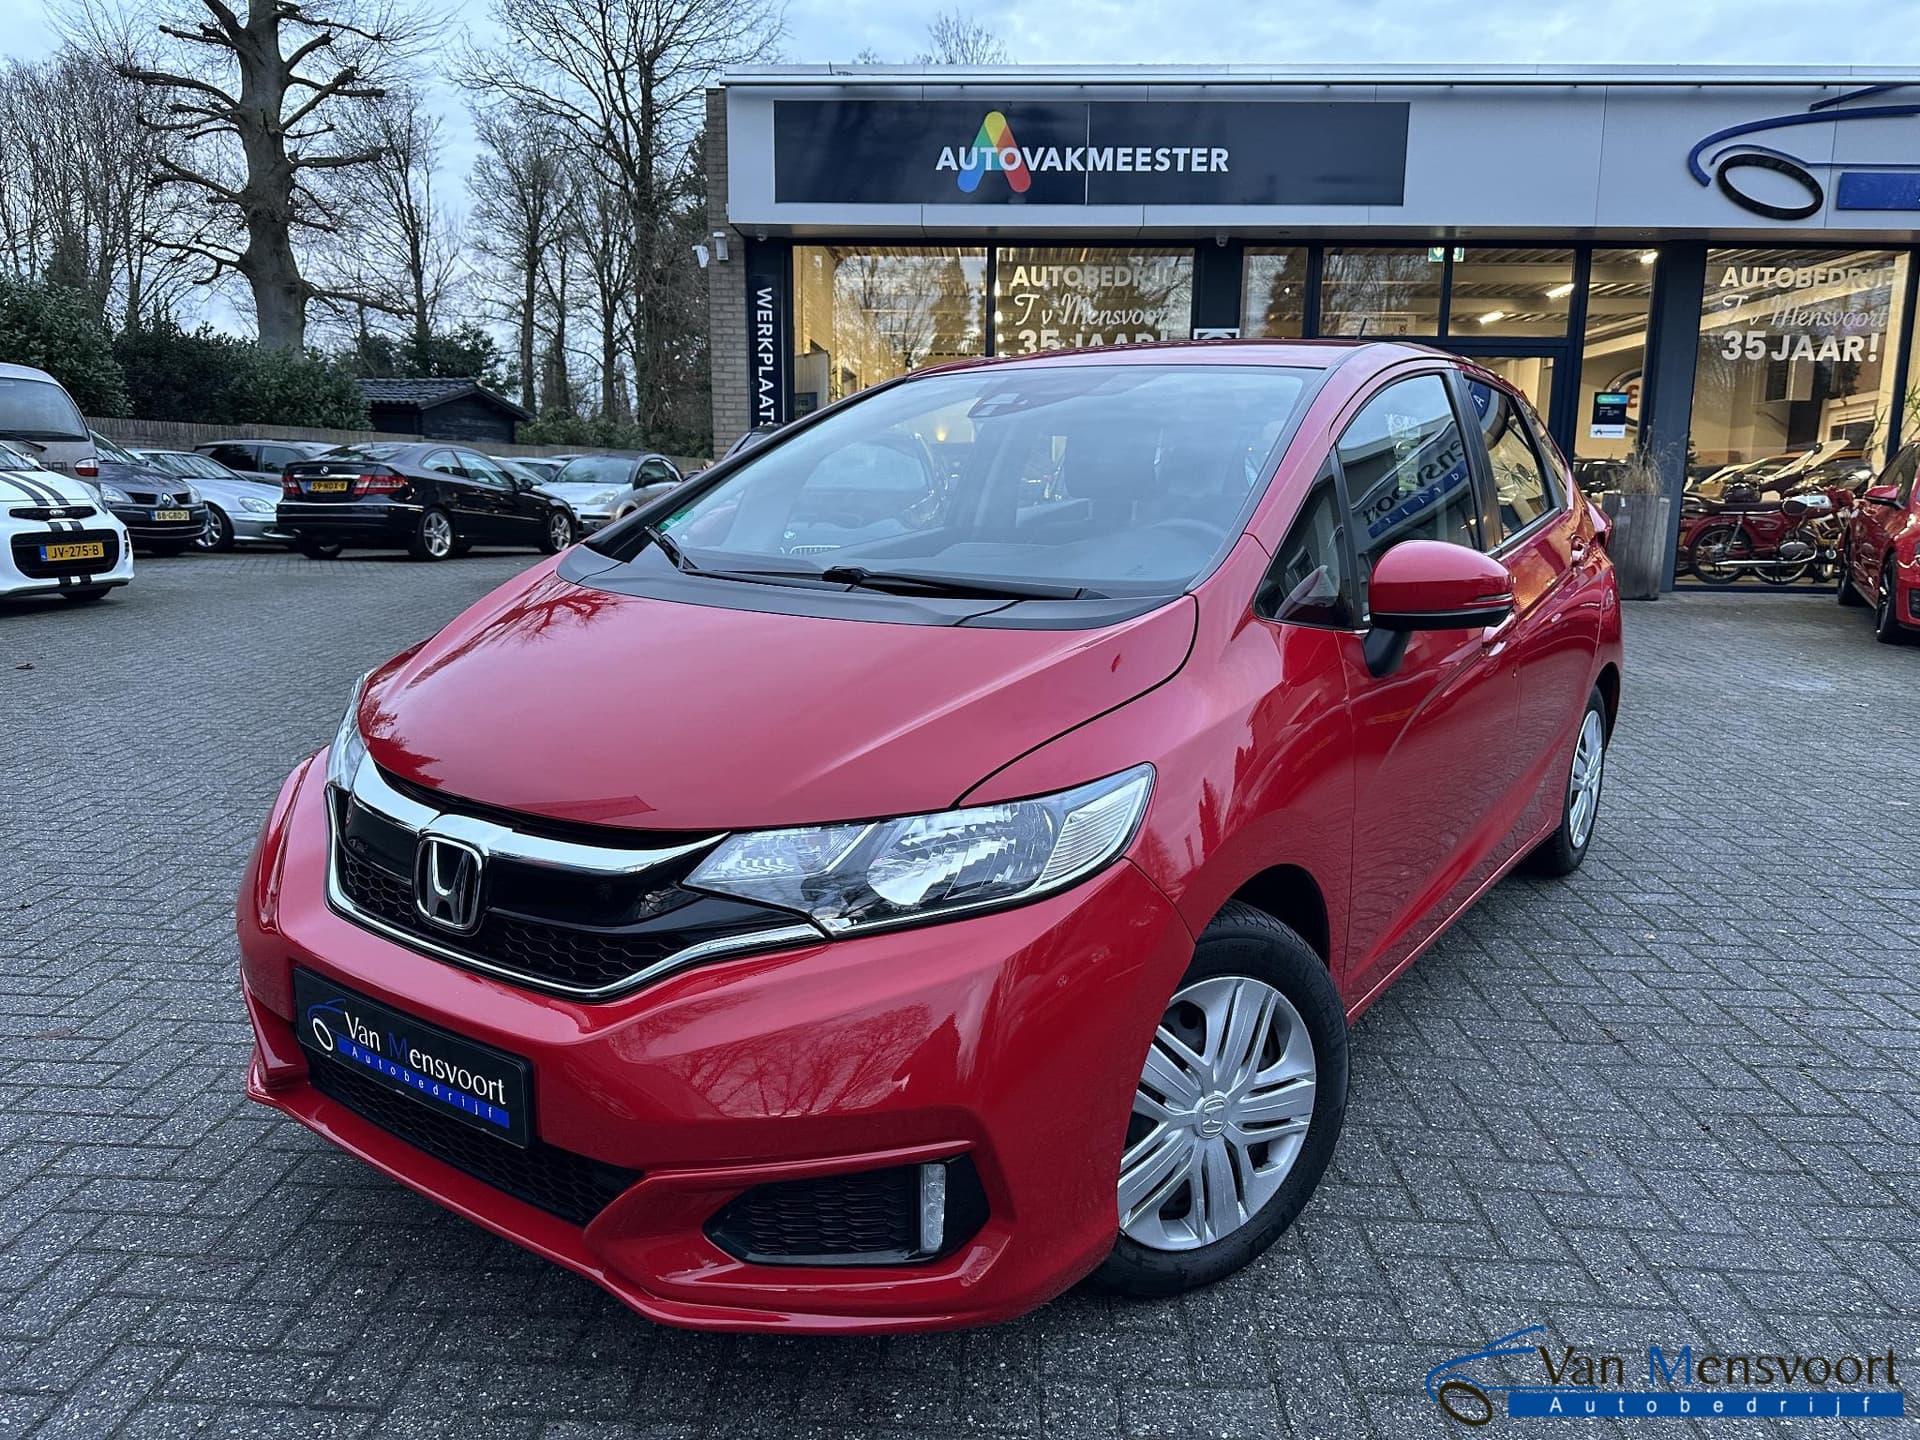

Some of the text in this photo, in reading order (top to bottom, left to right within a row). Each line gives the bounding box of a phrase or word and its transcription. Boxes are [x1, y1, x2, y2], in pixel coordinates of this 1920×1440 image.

[935, 146, 1229, 172] AUTOVAKMEESTER
[1769, 293, 1888, 328] Mensvoort
[1018, 330, 1060, 355] 35
[1721, 330, 1879, 362] 35 JAAR!
[51, 545, 100, 559] JV-275-B
[345, 1011, 506, 1105] Van Mensvoort
[351, 1047, 494, 1118] Autobedrijf
